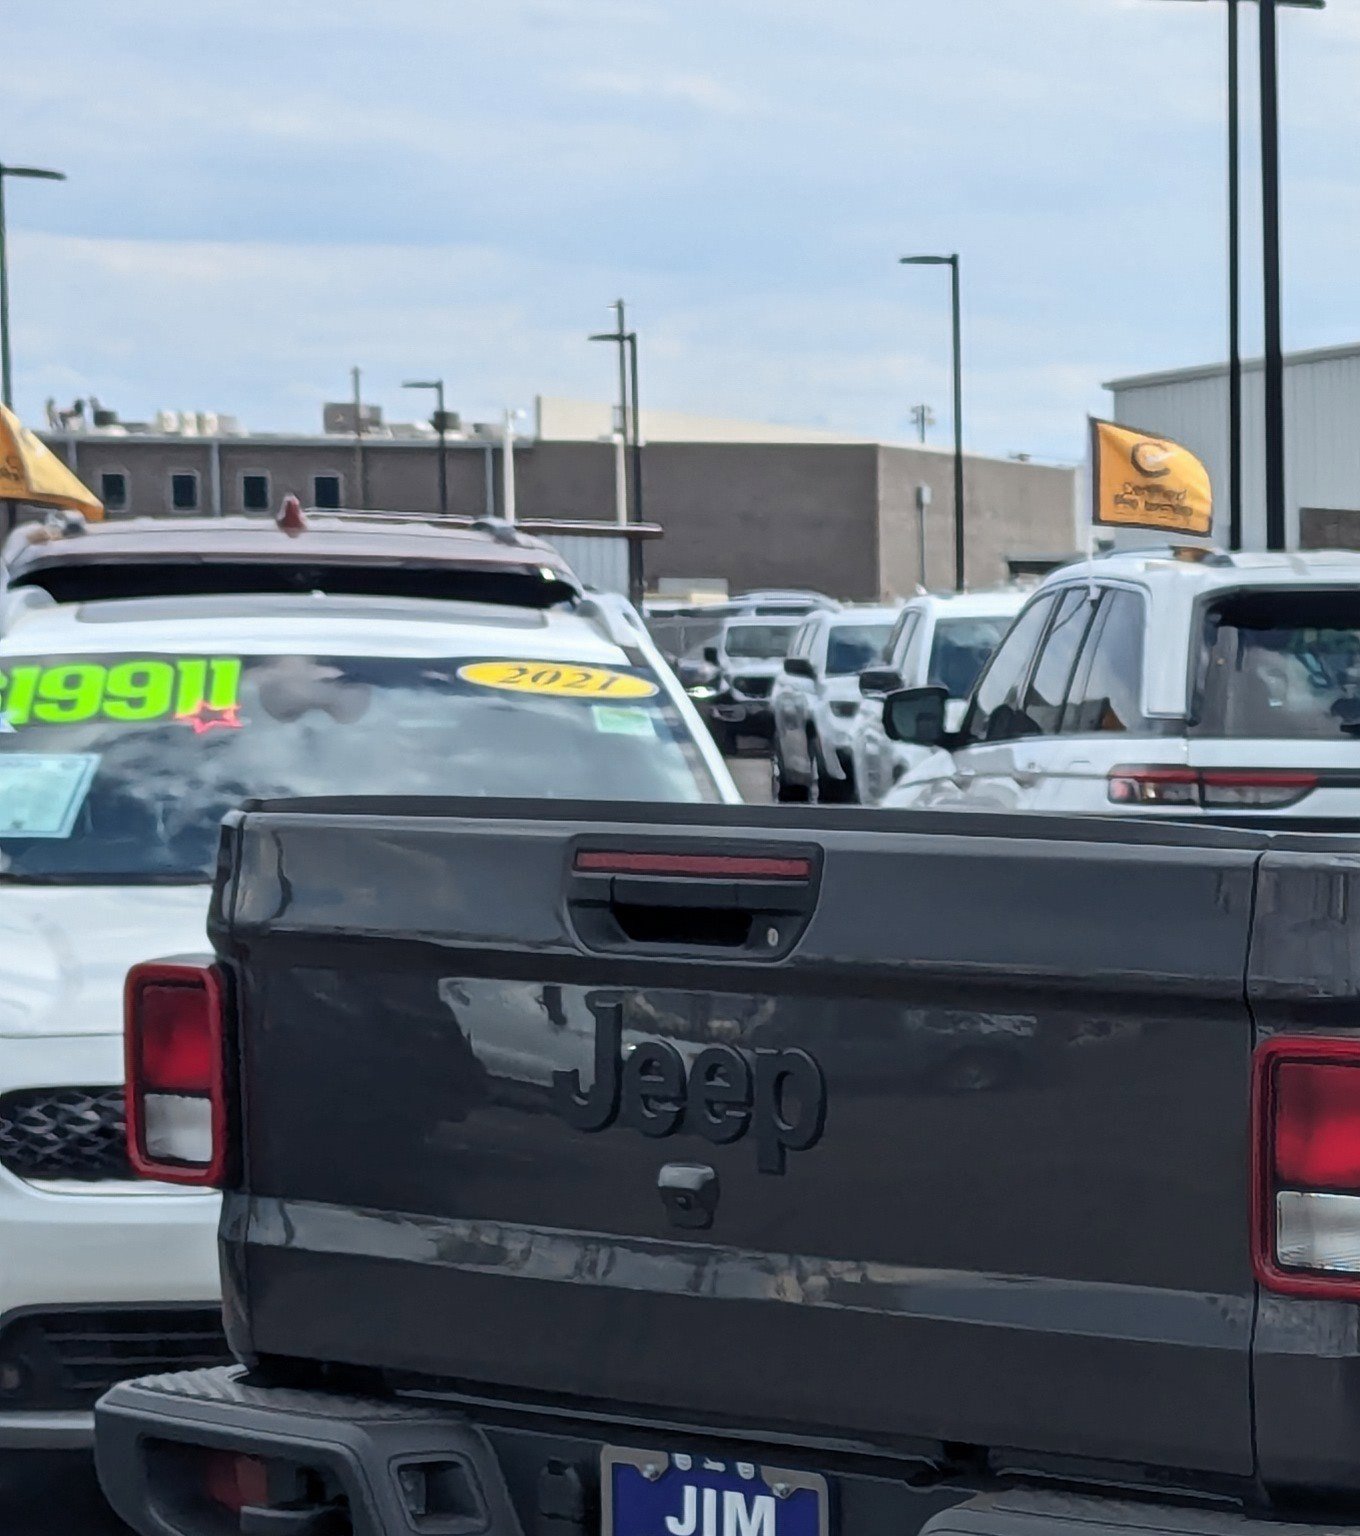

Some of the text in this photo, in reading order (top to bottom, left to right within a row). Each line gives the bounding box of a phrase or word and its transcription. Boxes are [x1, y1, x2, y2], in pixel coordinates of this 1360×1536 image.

[0, 658, 241, 725] 19911
[497, 666, 620, 691] 2021
[552, 989, 828, 1176] Jeep
